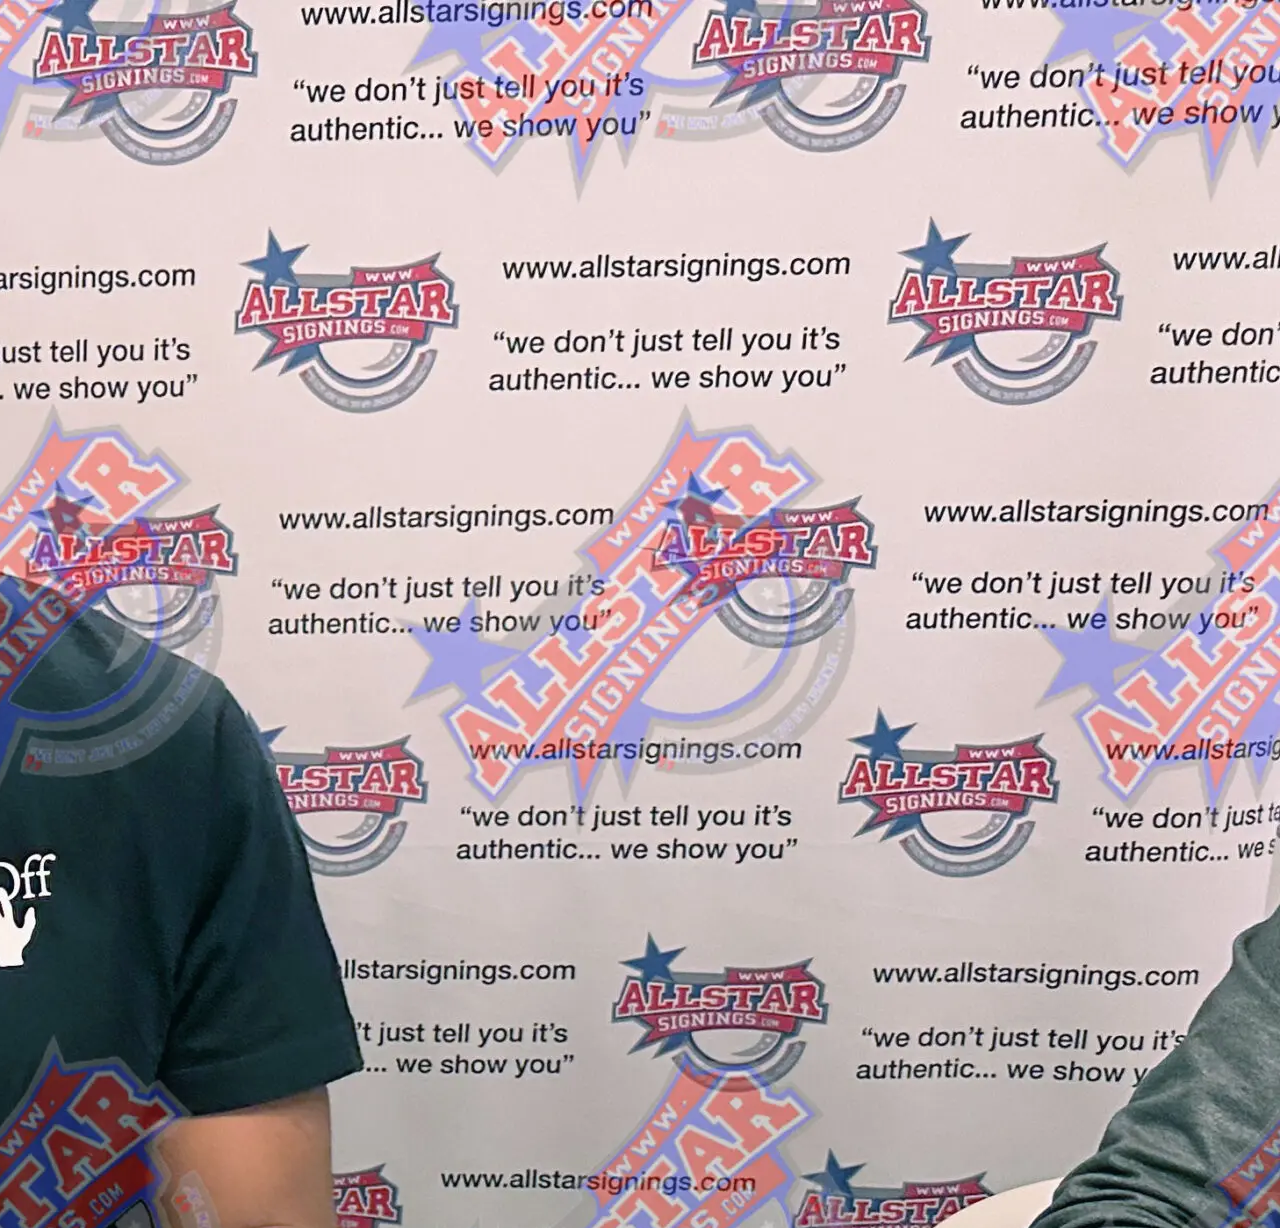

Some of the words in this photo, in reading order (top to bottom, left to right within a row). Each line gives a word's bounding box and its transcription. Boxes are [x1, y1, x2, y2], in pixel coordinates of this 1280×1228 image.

[300, 0, 656, 28] www.allstarsignings.com
[695, 10, 924, 62] ALLSTAR
[37, 28, 252, 77] ALLSTAR
[431, 75, 486, 108] just
[493, 73, 536, 100] tell
[544, 78, 597, 105] you
[289, 114, 444, 143] authentic...
[453, 119, 494, 139] we
[502, 111, 578, 138] show
[501, 251, 851, 284] www.allstarsignings.com
[238, 280, 451, 328] ALLSTAR
[891, 271, 1117, 318] ALLSTAR
[629, 327, 685, 359] just
[691, 326, 734, 352] tell
[740, 332, 793, 358] you
[488, 365, 641, 392] authentic...
[650, 370, 691, 390] we
[698, 363, 775, 389] show
[278, 503, 615, 534] www.allstarsignings.com
[923, 498, 1270, 529] www.allstarsignings.com
[1046, 570, 1103, 600] just
[1109, 570, 1153, 595] tell
[1159, 576, 1212, 601] you
[905, 605, 1056, 631] authentic...
[1066, 612, 1108, 630] we
[1115, 606, 1192, 631] show
[468, 732, 802, 765] www.allstarsignings.com
[841, 757, 1055, 799] ALLSTAR
[590, 804, 643, 833] just
[648, 804, 690, 827] tell
[695, 809, 746, 832] you
[455, 837, 601, 861] authentic...
[610, 842, 649, 860] we
[655, 837, 729, 860] show
[872, 961, 1200, 992] www.allstarsignings.com
[615, 978, 824, 1020] ALLSTAR
[987, 1025, 1041, 1053] just
[1046, 1028, 1089, 1051] tell
[1094, 1034, 1145, 1057] you
[855, 1057, 998, 1080] authentic...
[1006, 1063, 1045, 1080] we
[1052, 1060, 1127, 1083] show
[440, 1168, 756, 1196] www.allstarsignings.com
